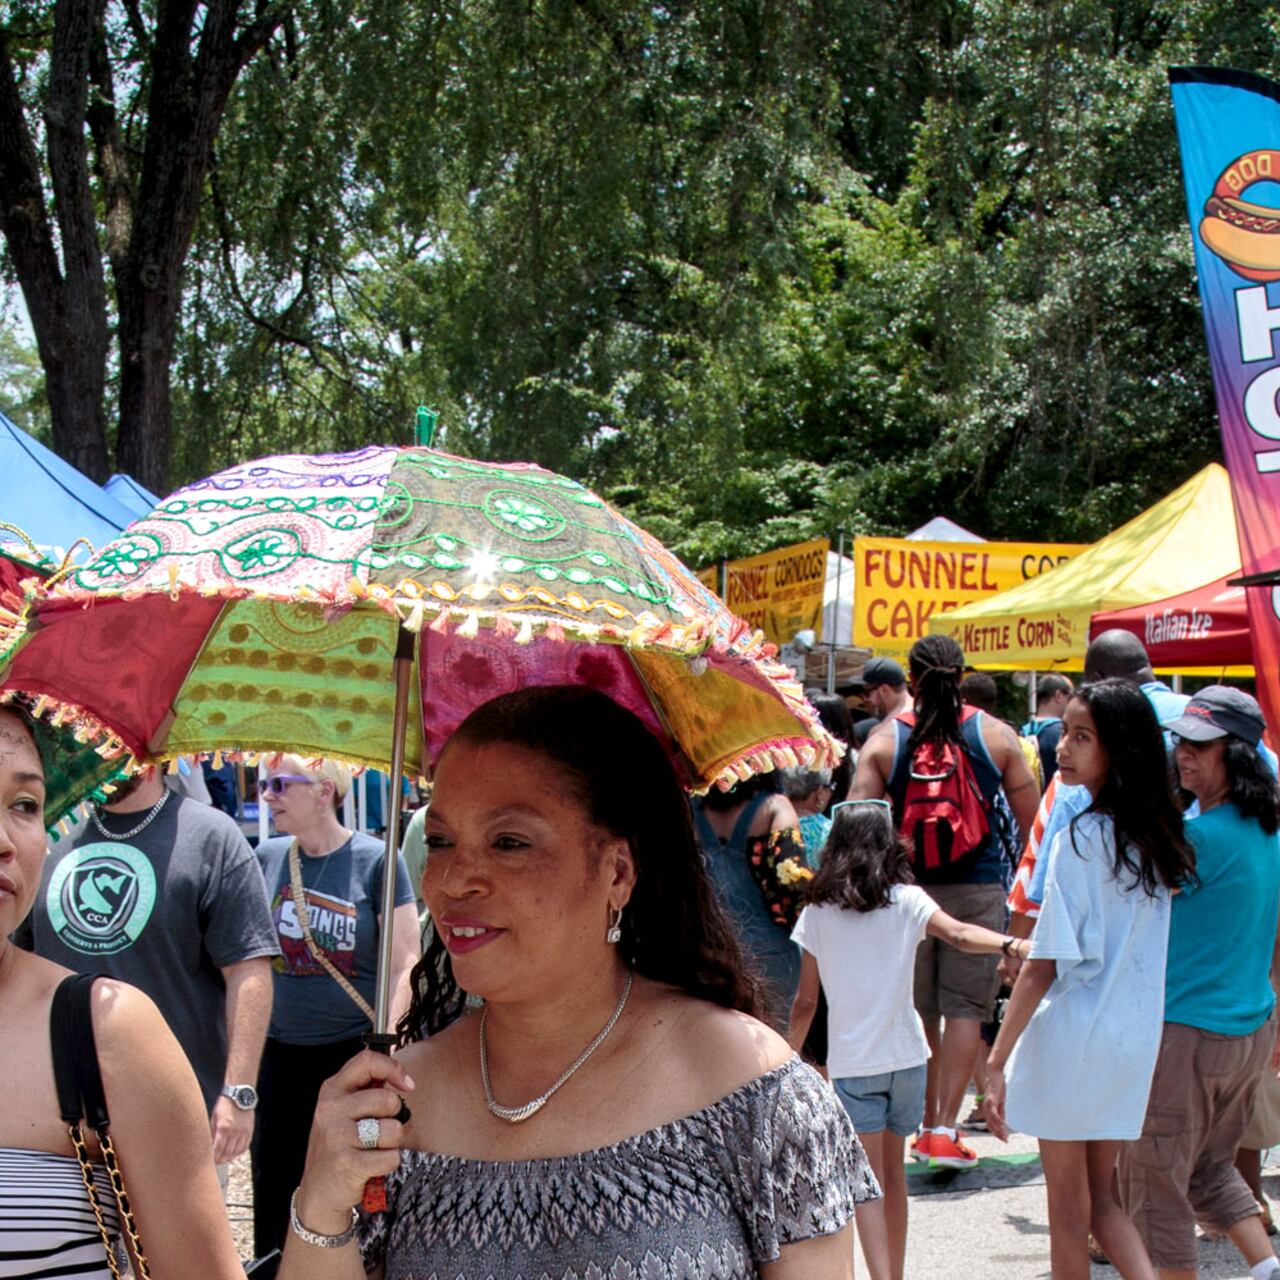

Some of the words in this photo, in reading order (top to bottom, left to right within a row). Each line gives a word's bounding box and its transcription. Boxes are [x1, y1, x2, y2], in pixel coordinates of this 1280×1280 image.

[864, 550, 998, 591] FUNNEL
[867, 598, 973, 638] CAK
[964, 624, 1009, 653] KETTLE
[1018, 617, 1055, 649] CORN
[86, 912, 109, 924] CCA
